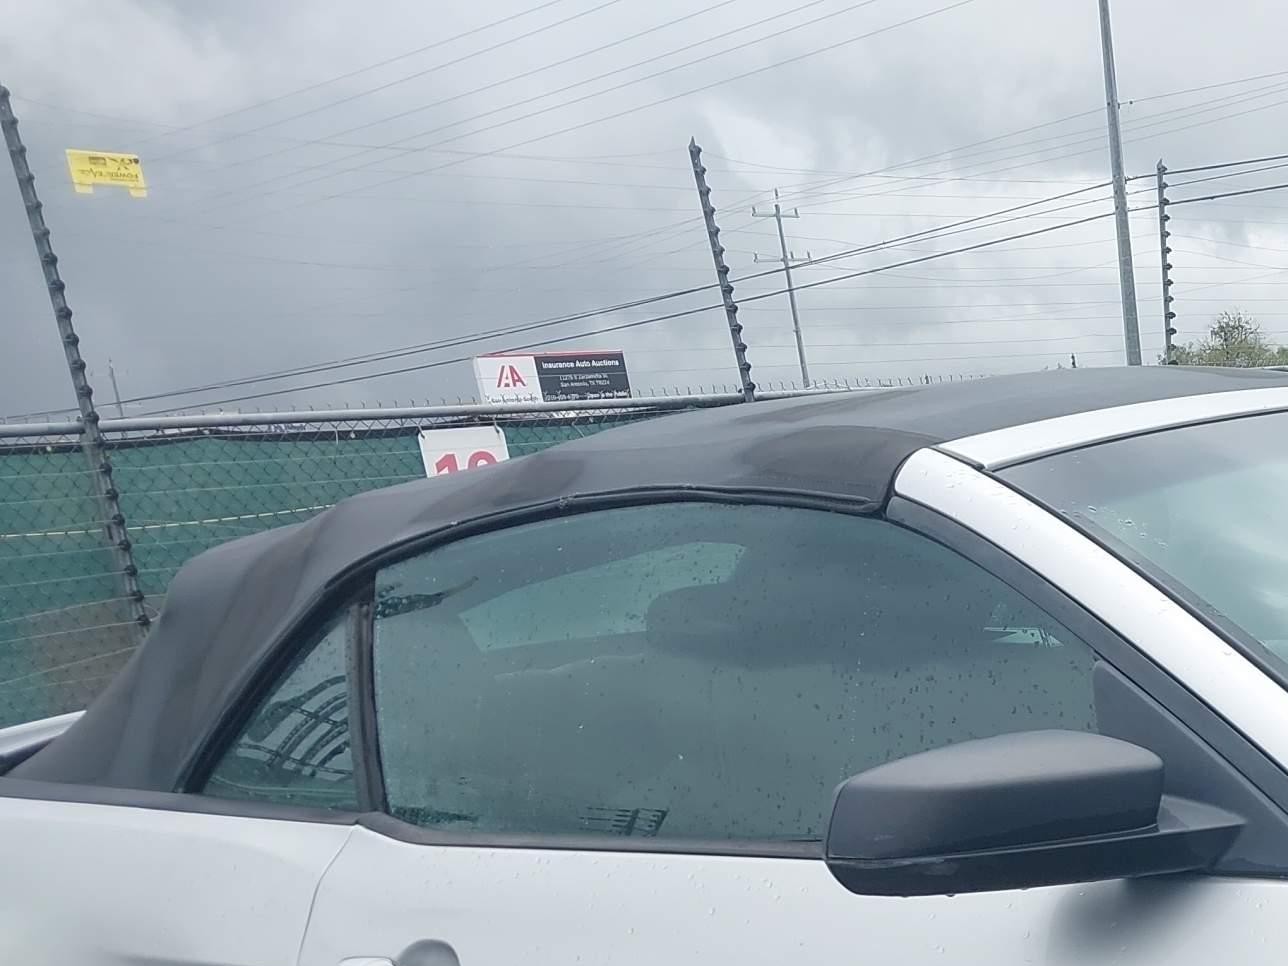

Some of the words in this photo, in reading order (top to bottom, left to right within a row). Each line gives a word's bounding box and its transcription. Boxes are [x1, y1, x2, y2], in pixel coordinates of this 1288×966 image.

[541, 361, 575, 369] Insurance
[575, 359, 591, 367] Auto
[591, 359, 620, 367] Auctions
